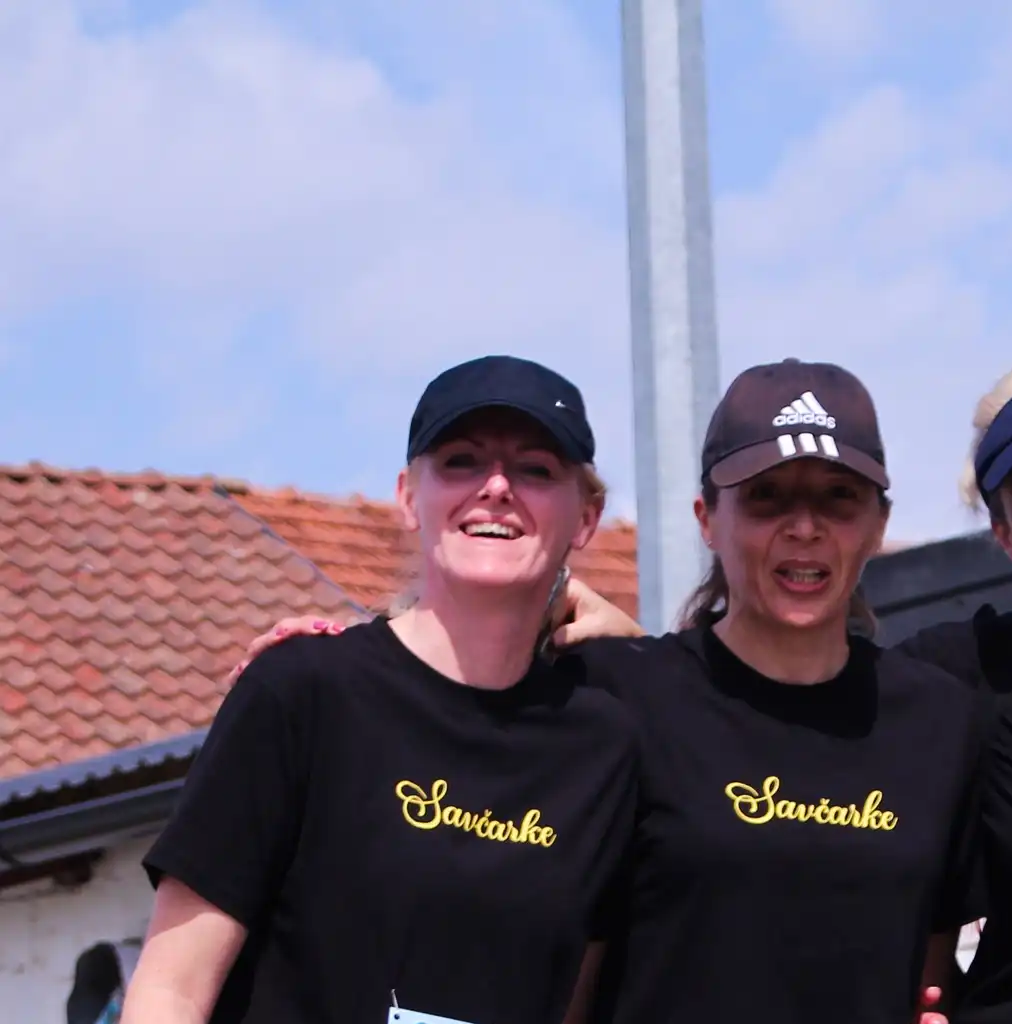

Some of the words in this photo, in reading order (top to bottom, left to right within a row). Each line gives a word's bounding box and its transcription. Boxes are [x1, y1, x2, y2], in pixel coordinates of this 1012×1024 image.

[772, 411, 837, 430] adidas
[395, 779, 557, 849] Savčarke
[725, 776, 898, 831] Savčarke
